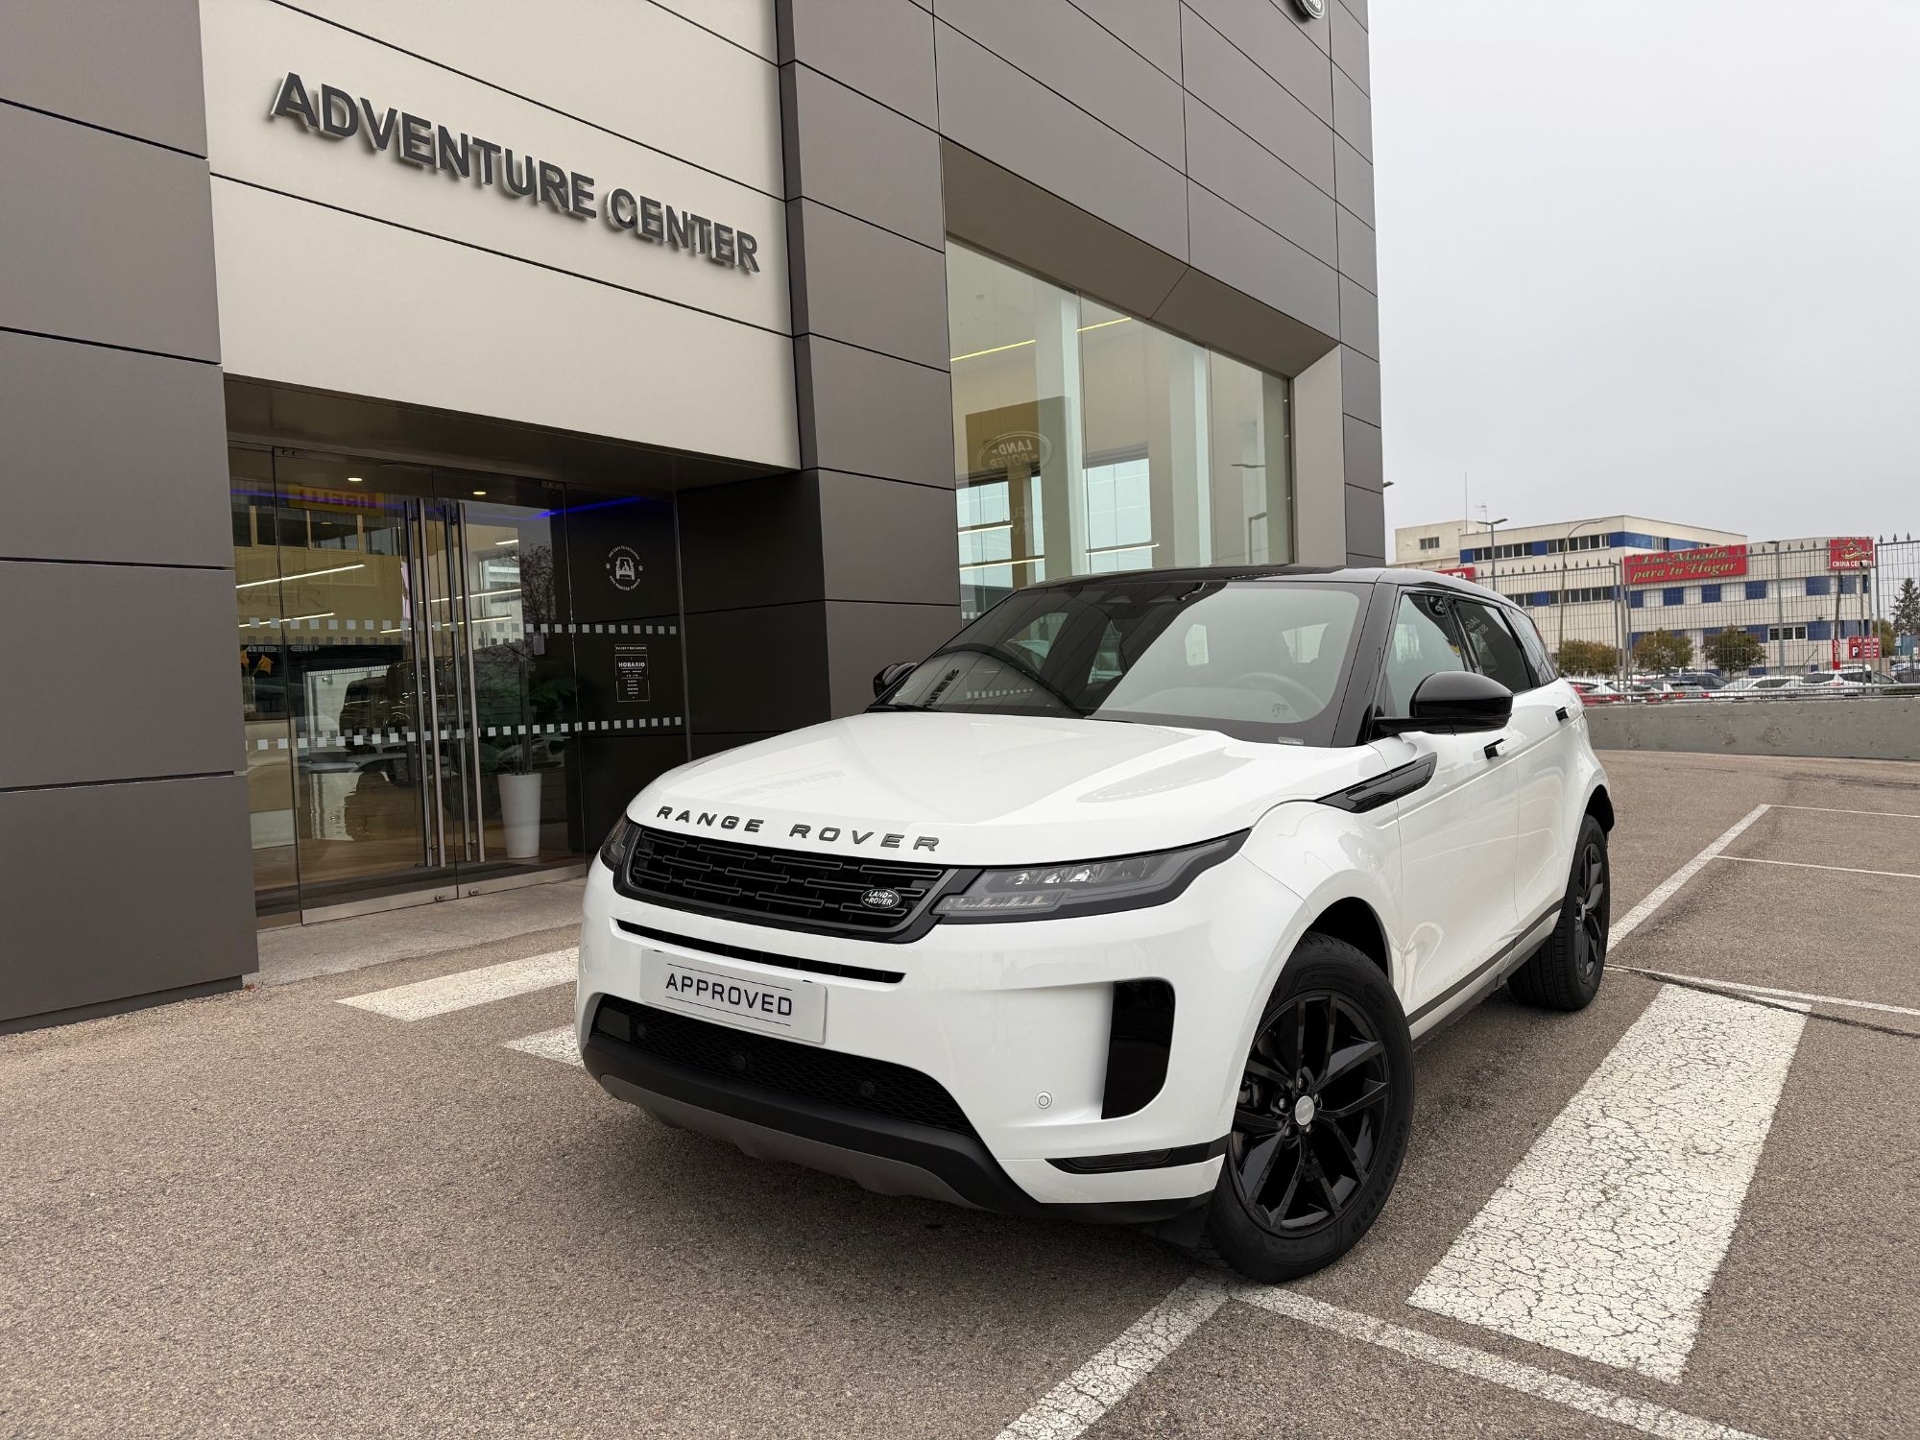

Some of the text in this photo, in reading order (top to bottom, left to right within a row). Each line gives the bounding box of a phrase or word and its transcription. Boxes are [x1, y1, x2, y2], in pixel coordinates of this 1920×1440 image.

[271, 71, 761, 273] ADVENTURE CENTER
[1633, 561, 1737, 582] para tu Hogar
[656, 805, 940, 852] RANGE ROVER
[665, 972, 793, 1017] APPROVED
